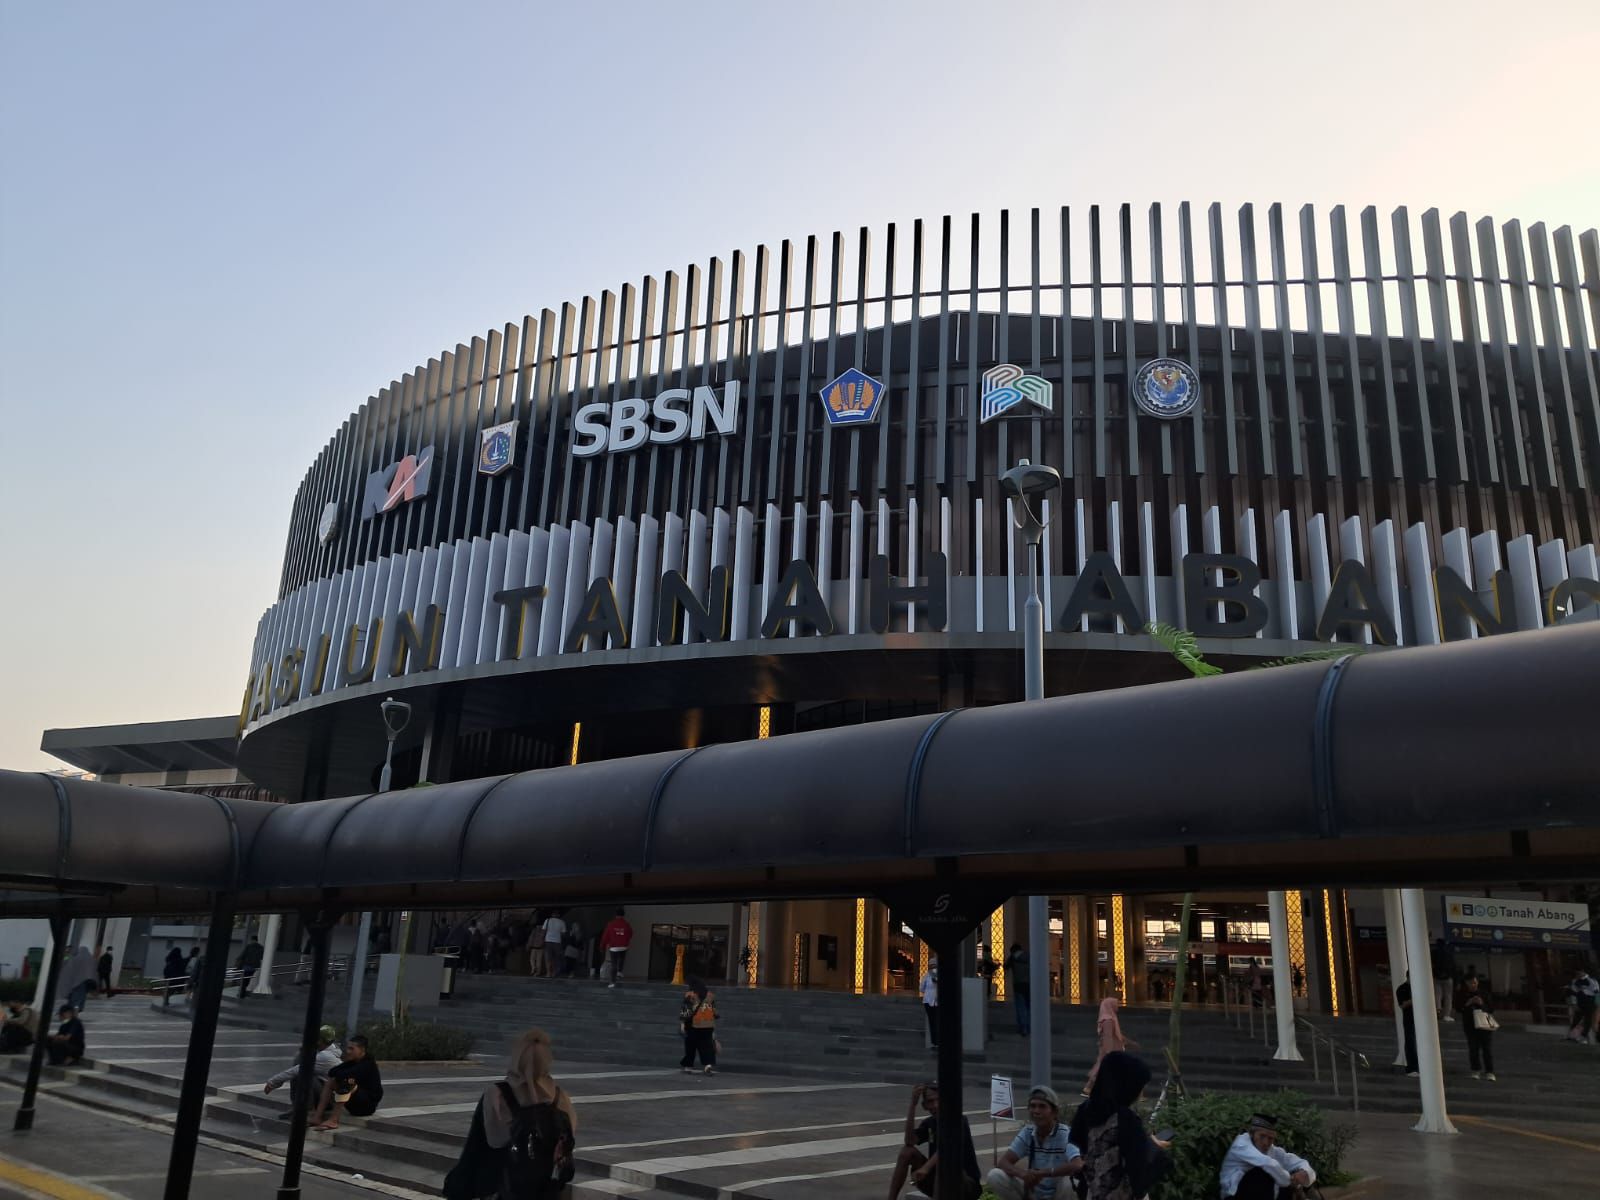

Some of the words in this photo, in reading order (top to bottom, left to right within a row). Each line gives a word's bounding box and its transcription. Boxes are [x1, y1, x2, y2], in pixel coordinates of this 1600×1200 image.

[572, 380, 741, 458] SBSN
[363, 445, 434, 519] KAI
[494, 551, 947, 661] TANAH
[1500, 906, 1534, 919] Tanah
[1538, 908, 1575, 923] Abang
